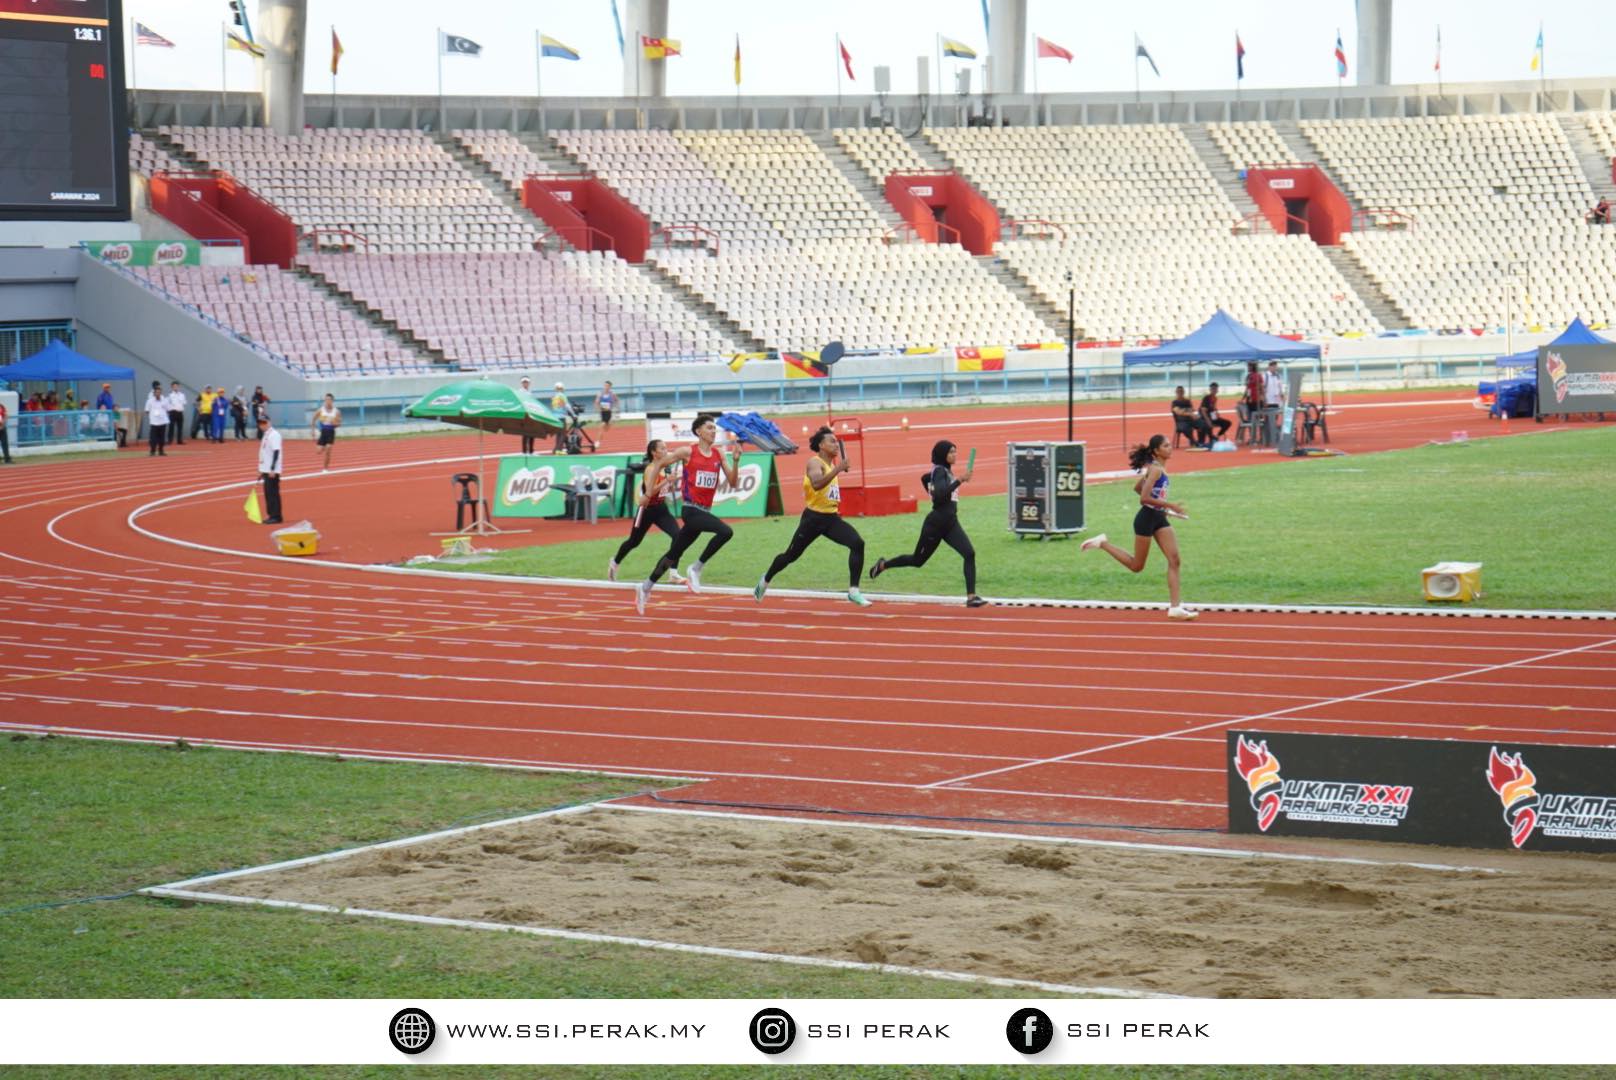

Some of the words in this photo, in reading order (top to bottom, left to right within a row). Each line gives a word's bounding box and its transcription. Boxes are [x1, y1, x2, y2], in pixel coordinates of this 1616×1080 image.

[103, 249, 129, 259] MILO
[157, 248, 184, 260] MILO
[509, 476, 549, 496] MILO
[1056, 471, 1081, 490] 5G
[1021, 505, 1039, 517] 5G
[1353, 803, 1409, 819] 2024
